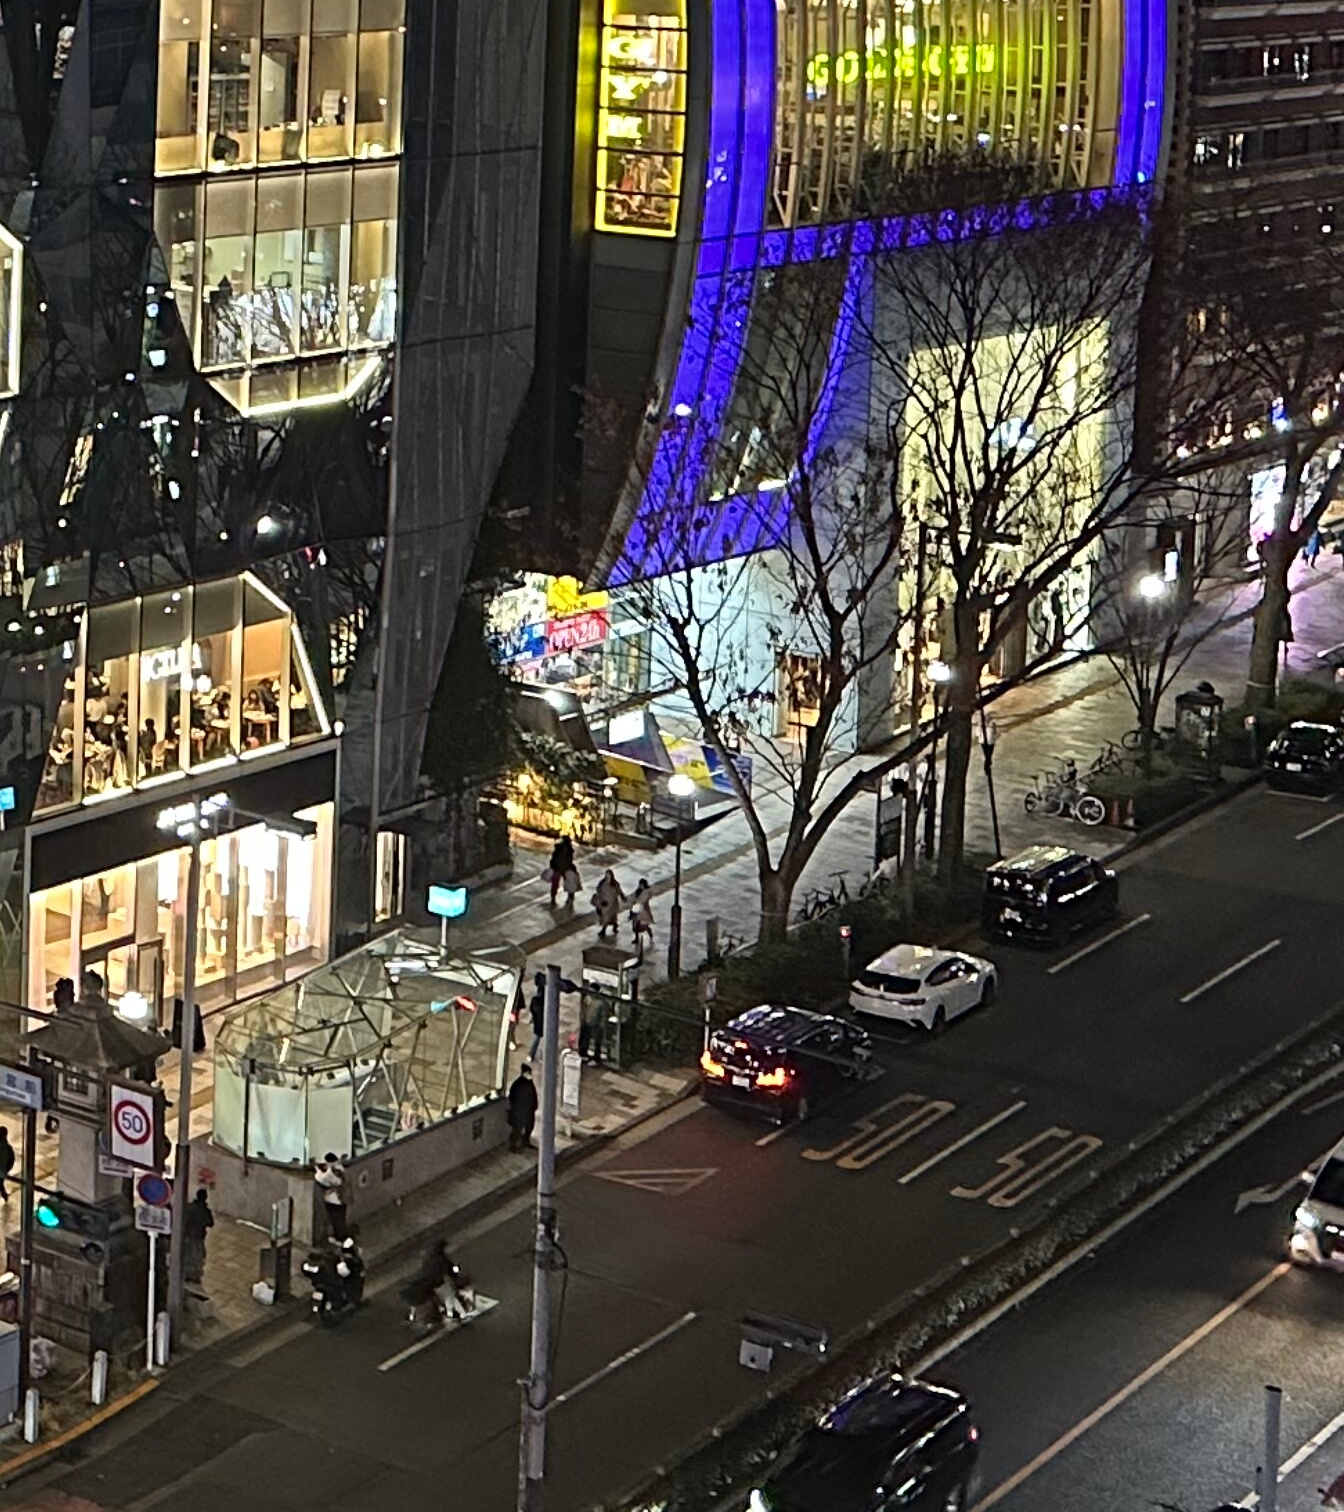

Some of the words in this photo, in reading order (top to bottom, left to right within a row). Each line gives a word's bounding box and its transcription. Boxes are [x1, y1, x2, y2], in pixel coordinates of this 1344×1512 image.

[121, 1111, 144, 1134] 50
[801, 1092, 956, 1170] 50
[949, 1126, 1104, 1208] 50
